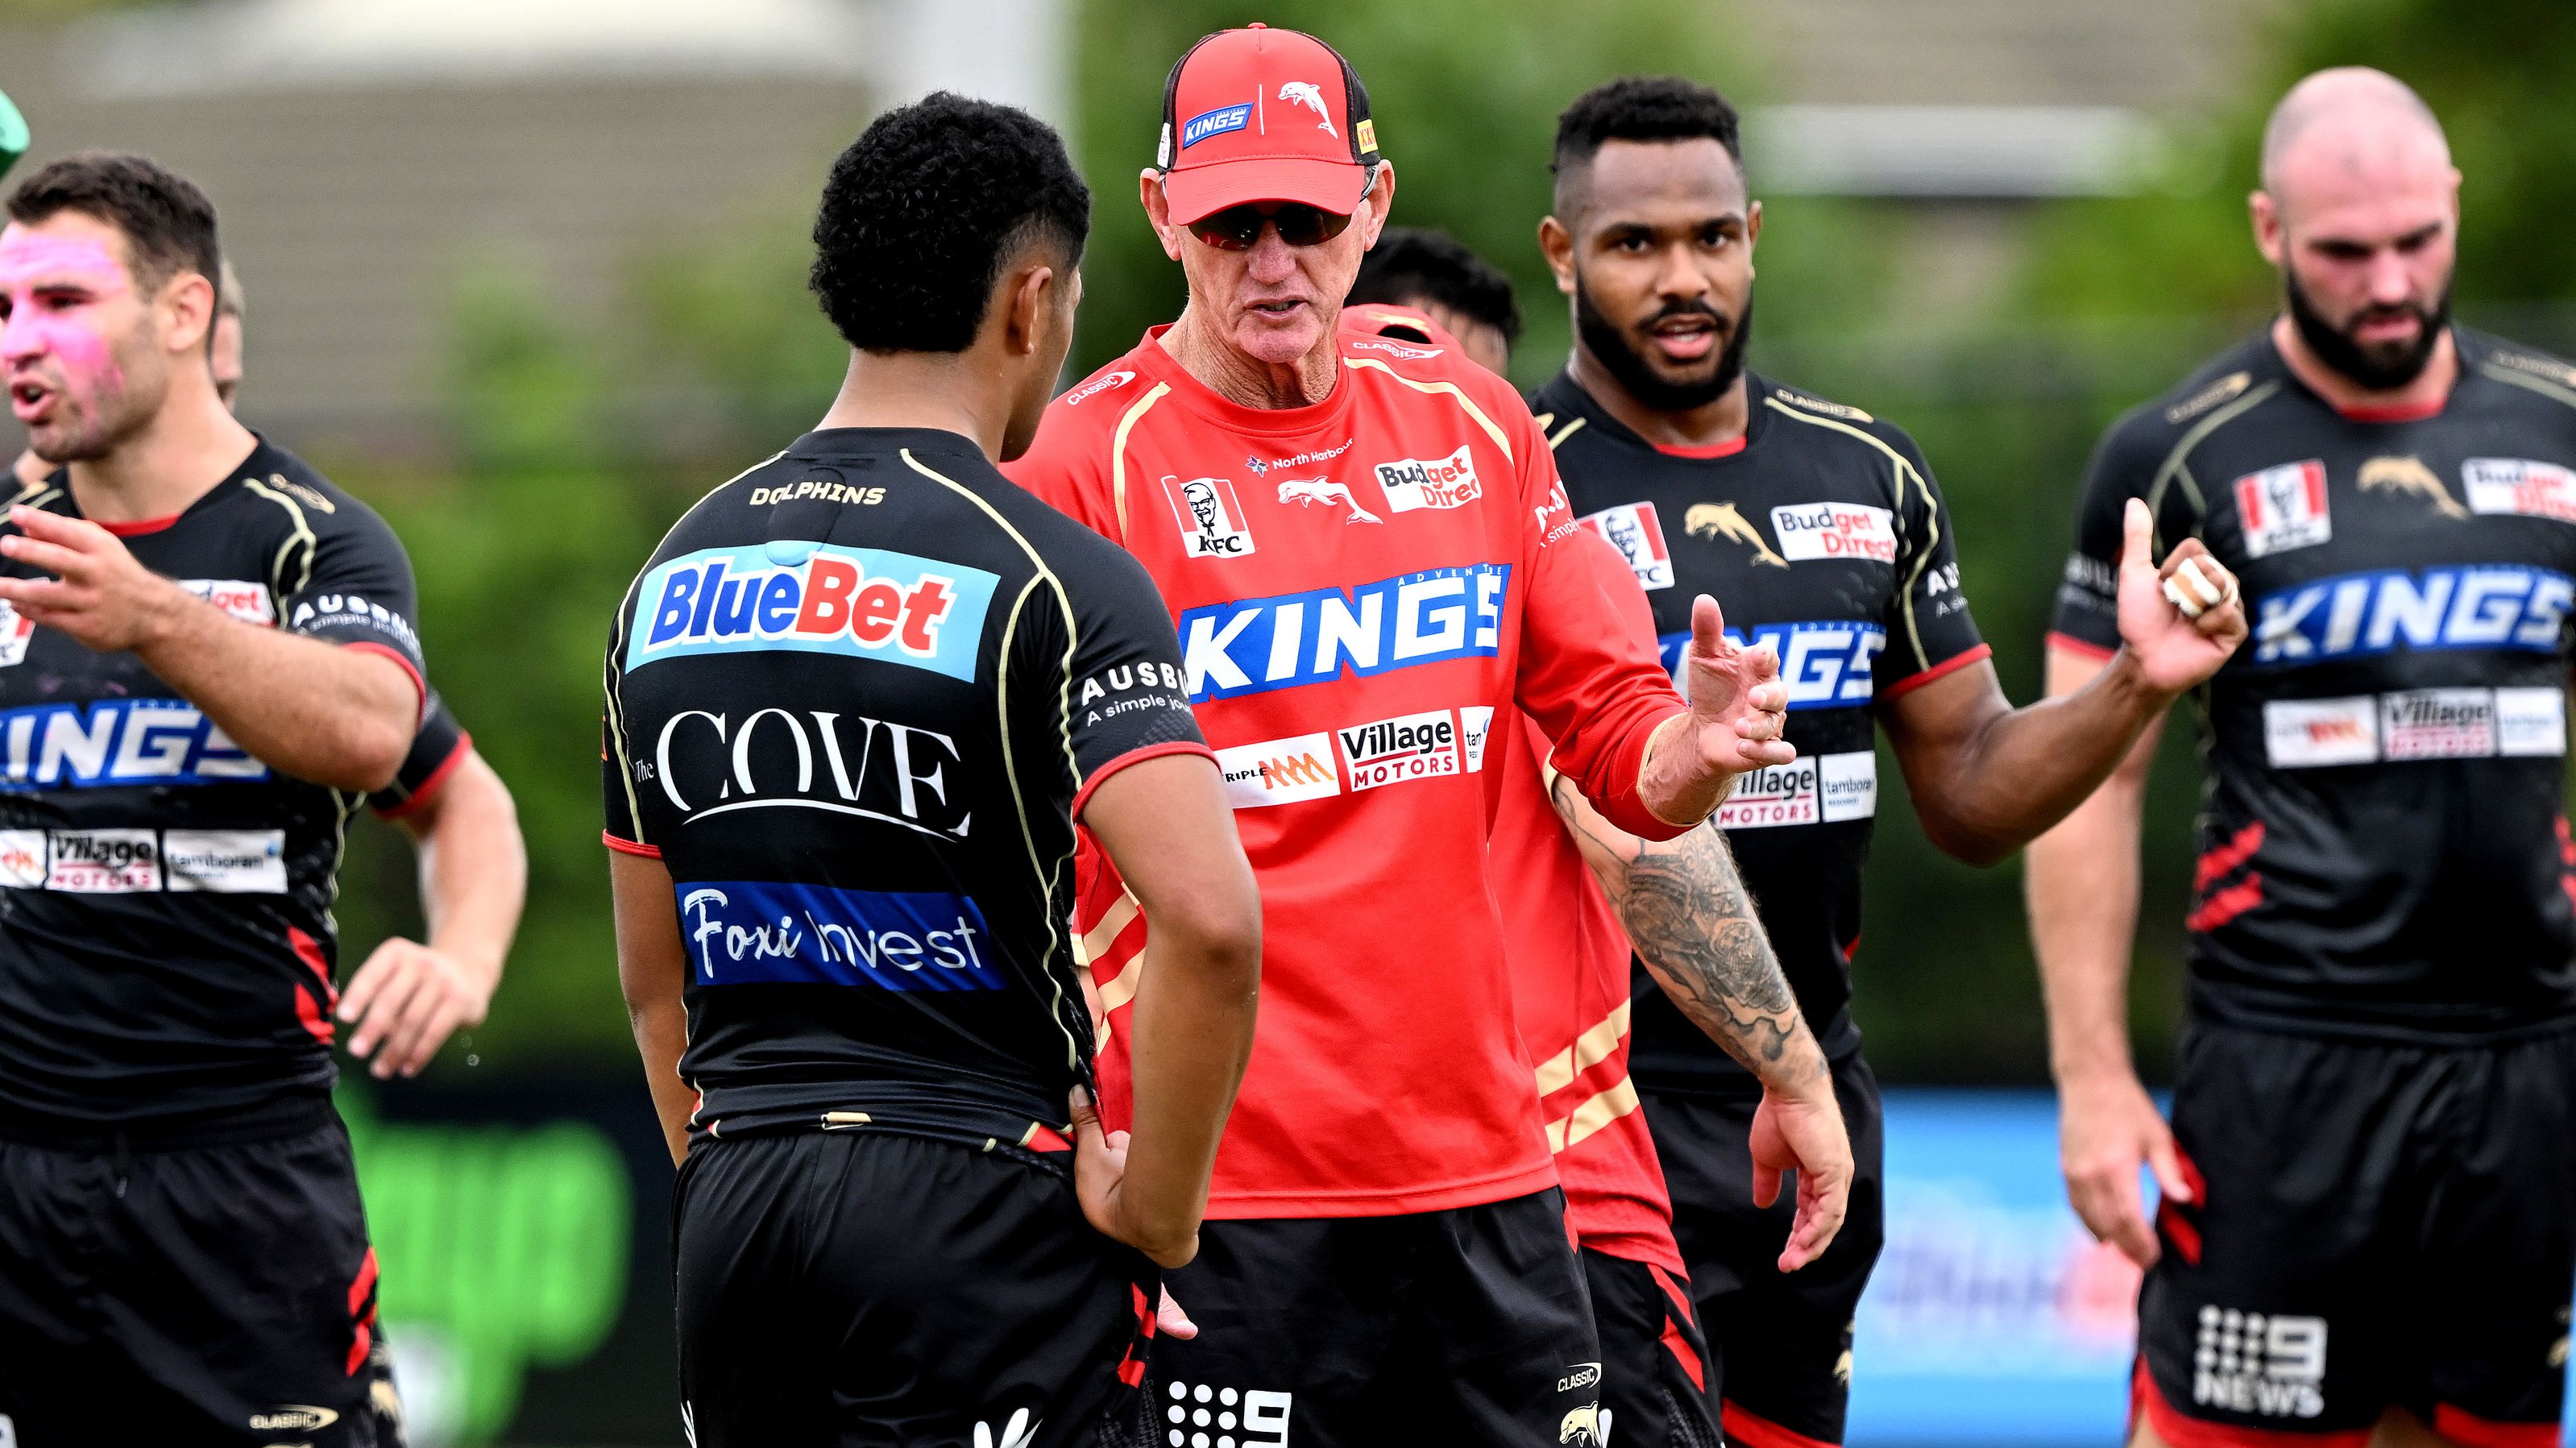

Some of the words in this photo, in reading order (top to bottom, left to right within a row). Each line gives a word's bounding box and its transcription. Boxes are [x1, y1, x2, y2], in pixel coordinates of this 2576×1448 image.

[1185, 108, 1247, 142] KINGS
[1353, 342, 1417, 358] CLASSIC
[1067, 376, 1118, 405] CLASSIC
[1272, 453, 1310, 469] North
[1310, 438, 1354, 462] Harbour
[1379, 456, 1469, 489] Budget
[749, 482, 886, 506] DOLPHINS
[1778, 506, 1875, 533] Budget
[1198, 535, 1242, 554] KFC
[648, 558, 949, 651] BlueBet
[2256, 571, 2575, 662] KINGS
[1184, 572, 1504, 695] KINGS
[1088, 710, 1102, 727] A
[1105, 694, 1166, 719] simple
[1341, 721, 1452, 759] Village
[635, 758, 654, 782] The
[656, 707, 971, 836] COVE
[1222, 765, 1267, 783] RIPLE
[1354, 756, 1454, 789] MOTORS
[1741, 767, 1814, 800] illage
[1719, 805, 1813, 826] MOTORS
[56, 836, 151, 869] Village
[55, 873, 151, 886] MOTORS
[682, 888, 803, 978] Foxi
[2265, 1314, 2328, 1381] 9
[1558, 1367, 1595, 1392] CLASSIC
[2193, 1371, 2325, 1419] NEWS
[249, 1413, 315, 1429] CLASSIC
[1242, 1389, 1292, 1448] 9
